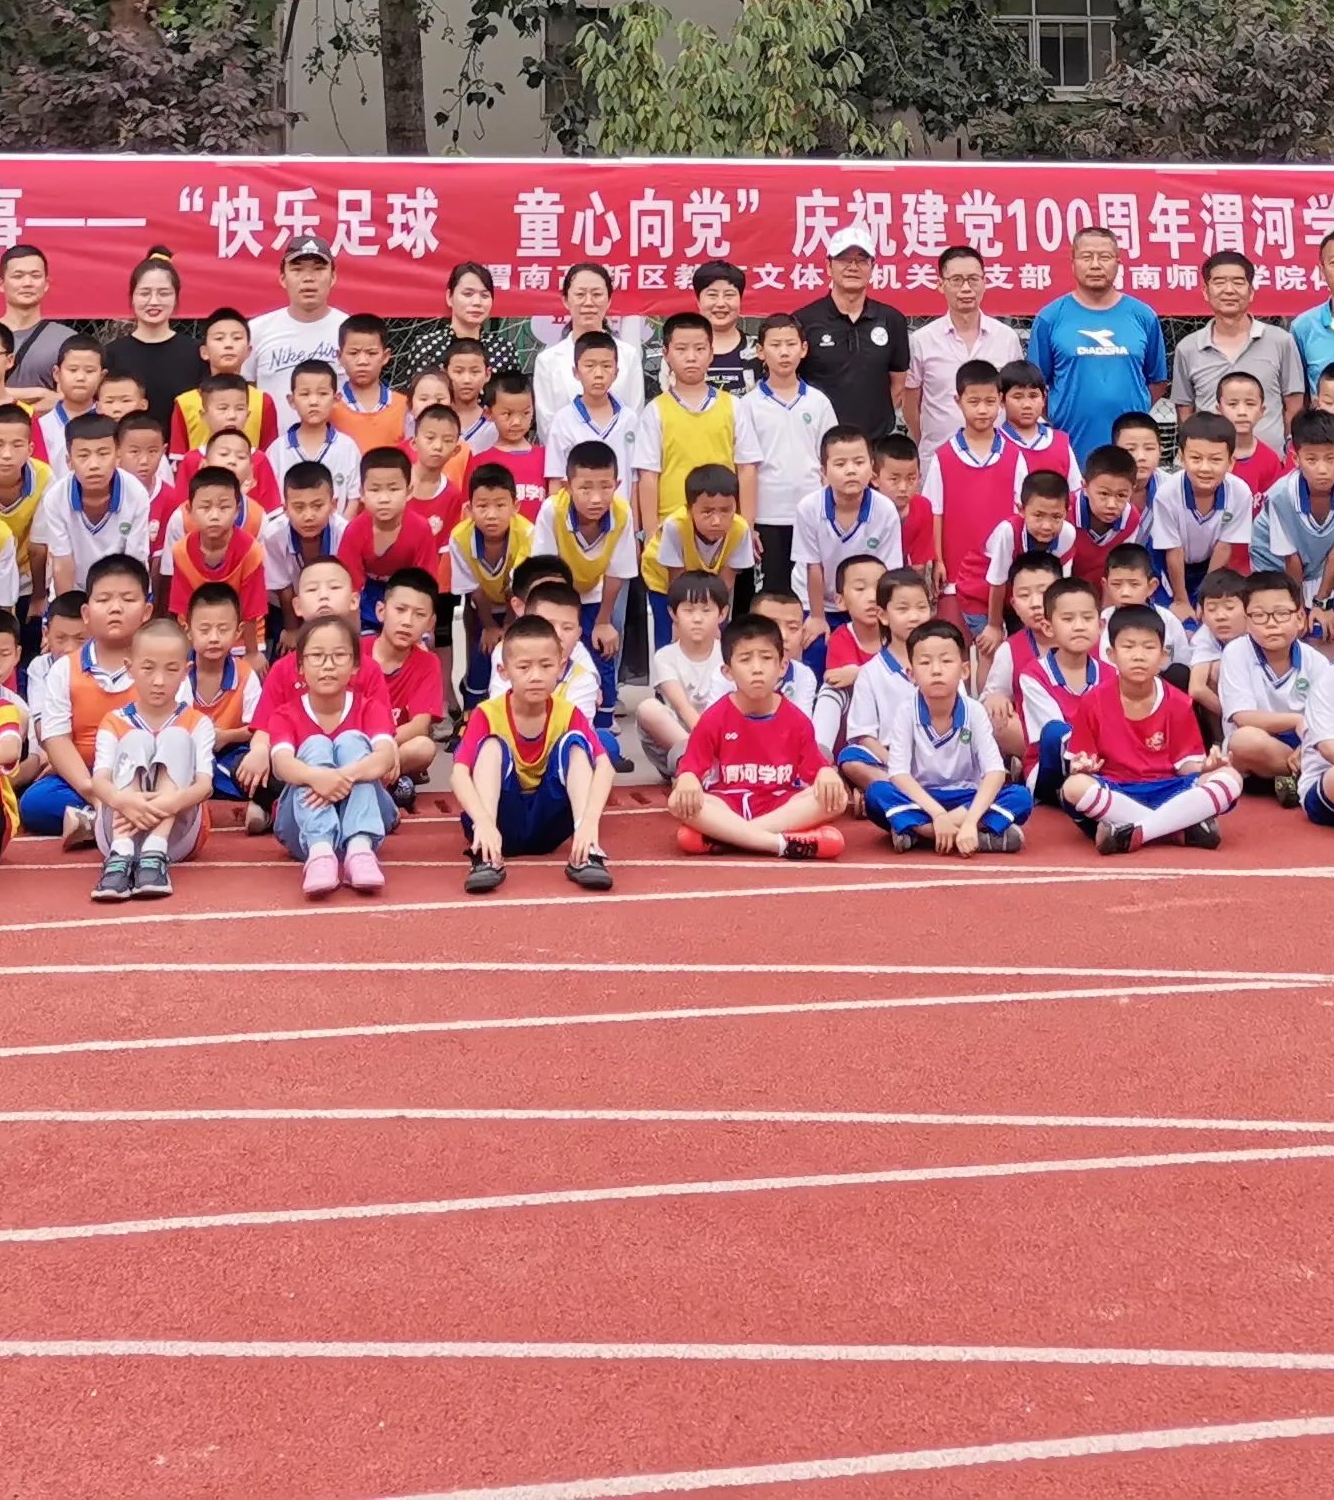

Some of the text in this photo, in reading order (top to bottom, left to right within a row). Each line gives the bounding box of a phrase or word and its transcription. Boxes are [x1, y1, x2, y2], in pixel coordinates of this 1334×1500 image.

[270, 346, 305, 372] Nike
[721, 763, 794, 786] 渭河学校
